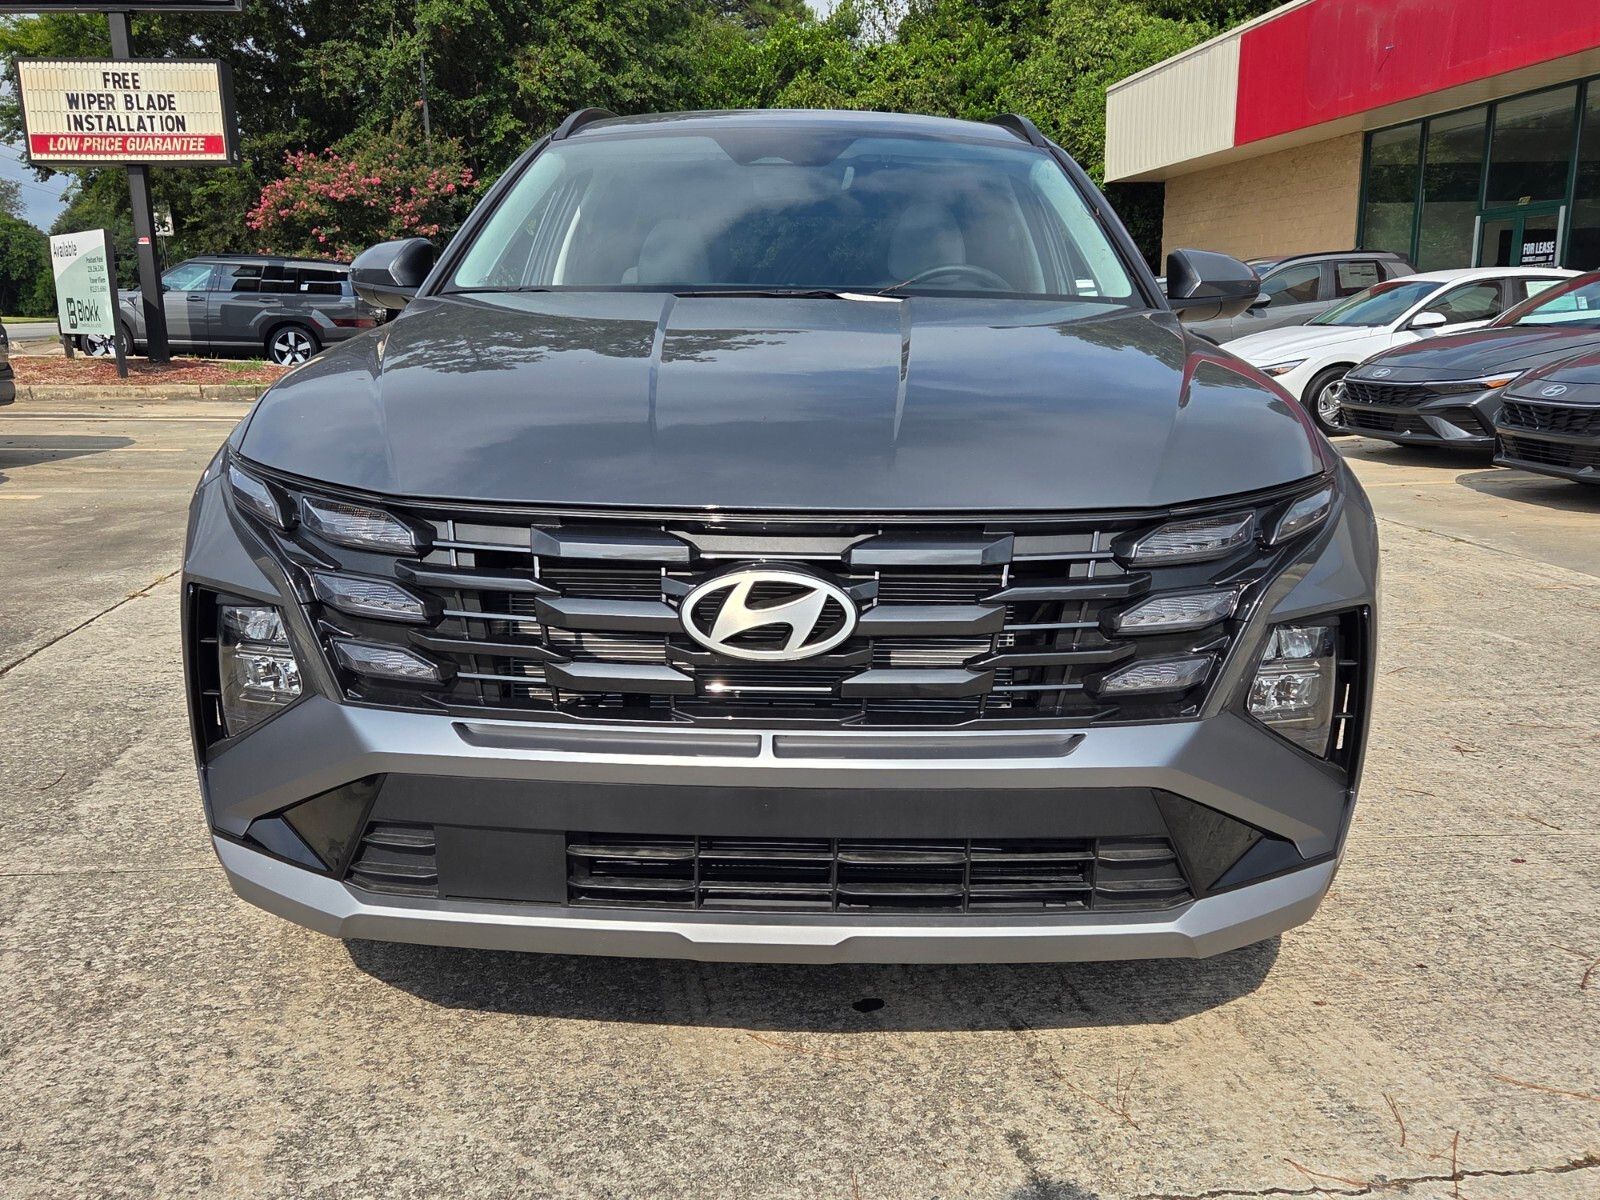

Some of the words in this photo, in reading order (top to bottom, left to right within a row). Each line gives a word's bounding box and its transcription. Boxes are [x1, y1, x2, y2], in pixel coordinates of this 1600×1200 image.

[103, 72, 140, 90] FREE
[66, 92, 116, 111] WIPER
[124, 93, 176, 111] BLADE
[66, 114, 187, 132] INSTALLATION
[49, 136, 79, 151] LOW
[83, 136, 123, 151] PRICE
[126, 136, 205, 151] GUARANTEE
[53, 241, 77, 258] Available
[1523, 242, 1535, 255] FOR
[1535, 241, 1555, 254] LEASE
[77, 299, 101, 322] Blokk
